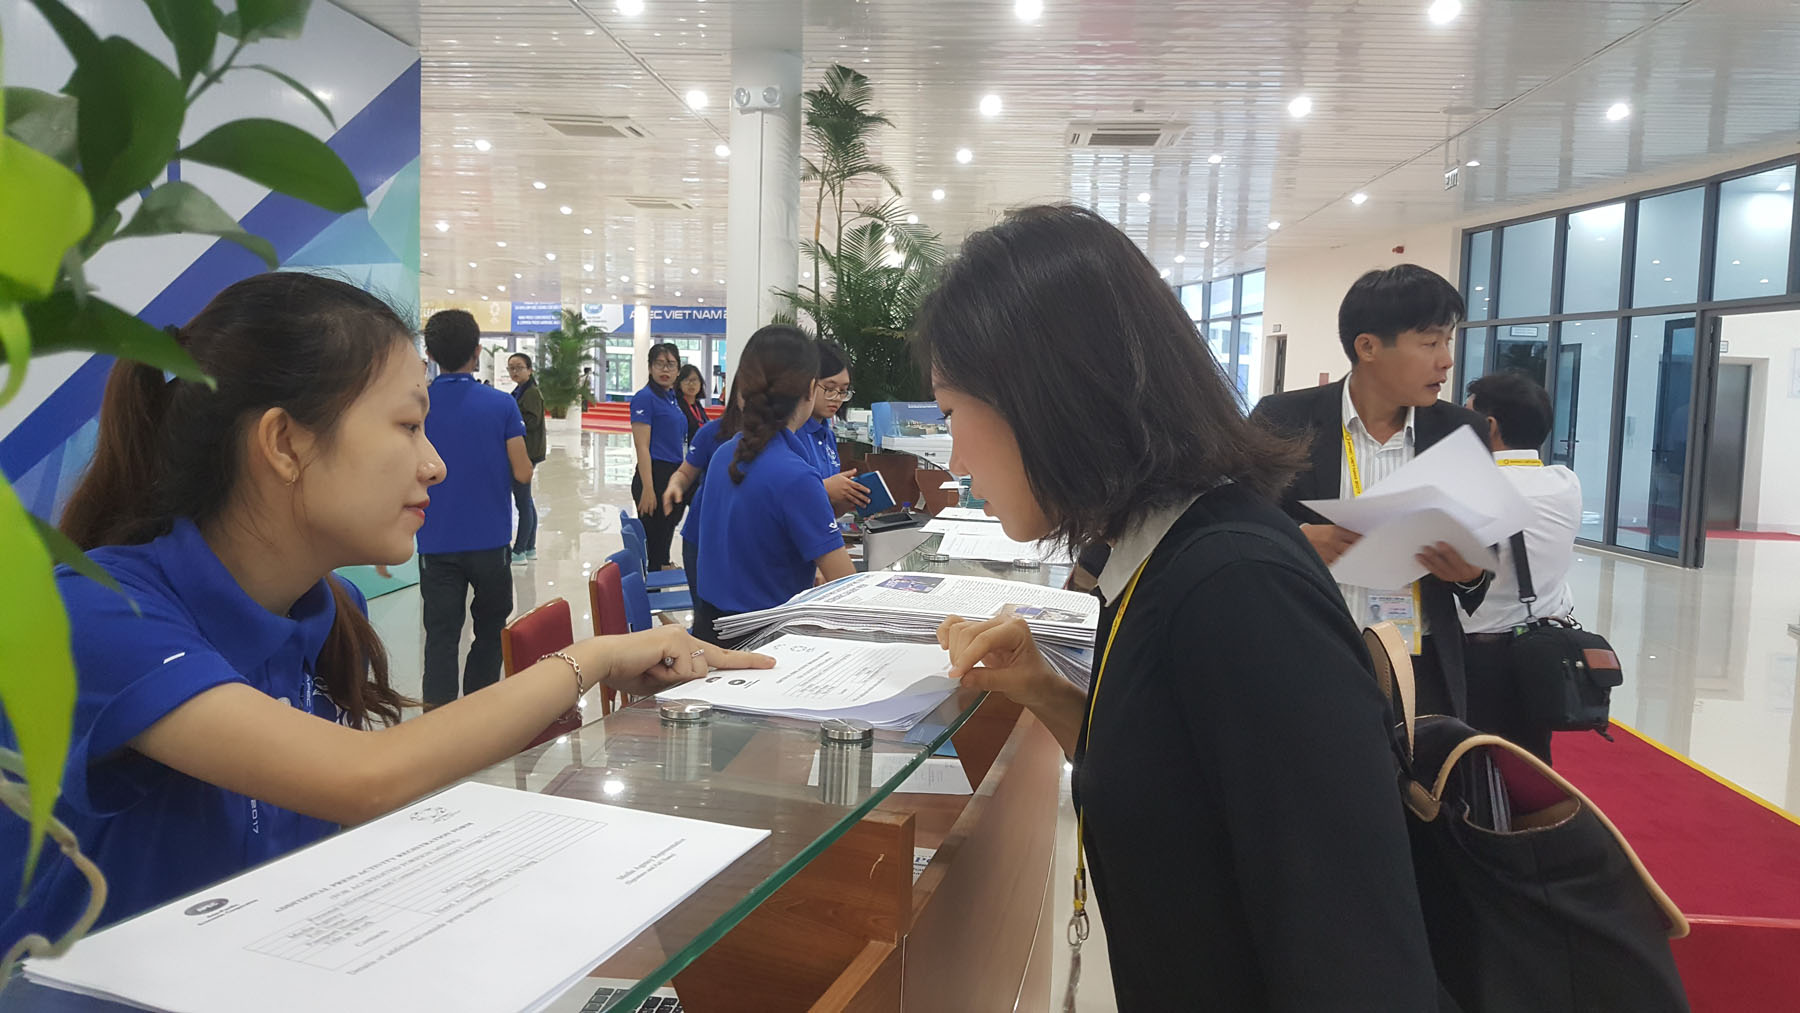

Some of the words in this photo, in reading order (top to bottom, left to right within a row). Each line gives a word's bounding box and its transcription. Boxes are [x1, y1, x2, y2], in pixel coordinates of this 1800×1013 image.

[664, 310, 691, 319] VIET
[693, 310, 722, 319] NAM
[272, 887, 329, 912] ADDITIONAL
[329, 874, 357, 886] PRESS
[394, 832, 452, 857] REGISTRATION
[449, 822, 473, 832] FORM
